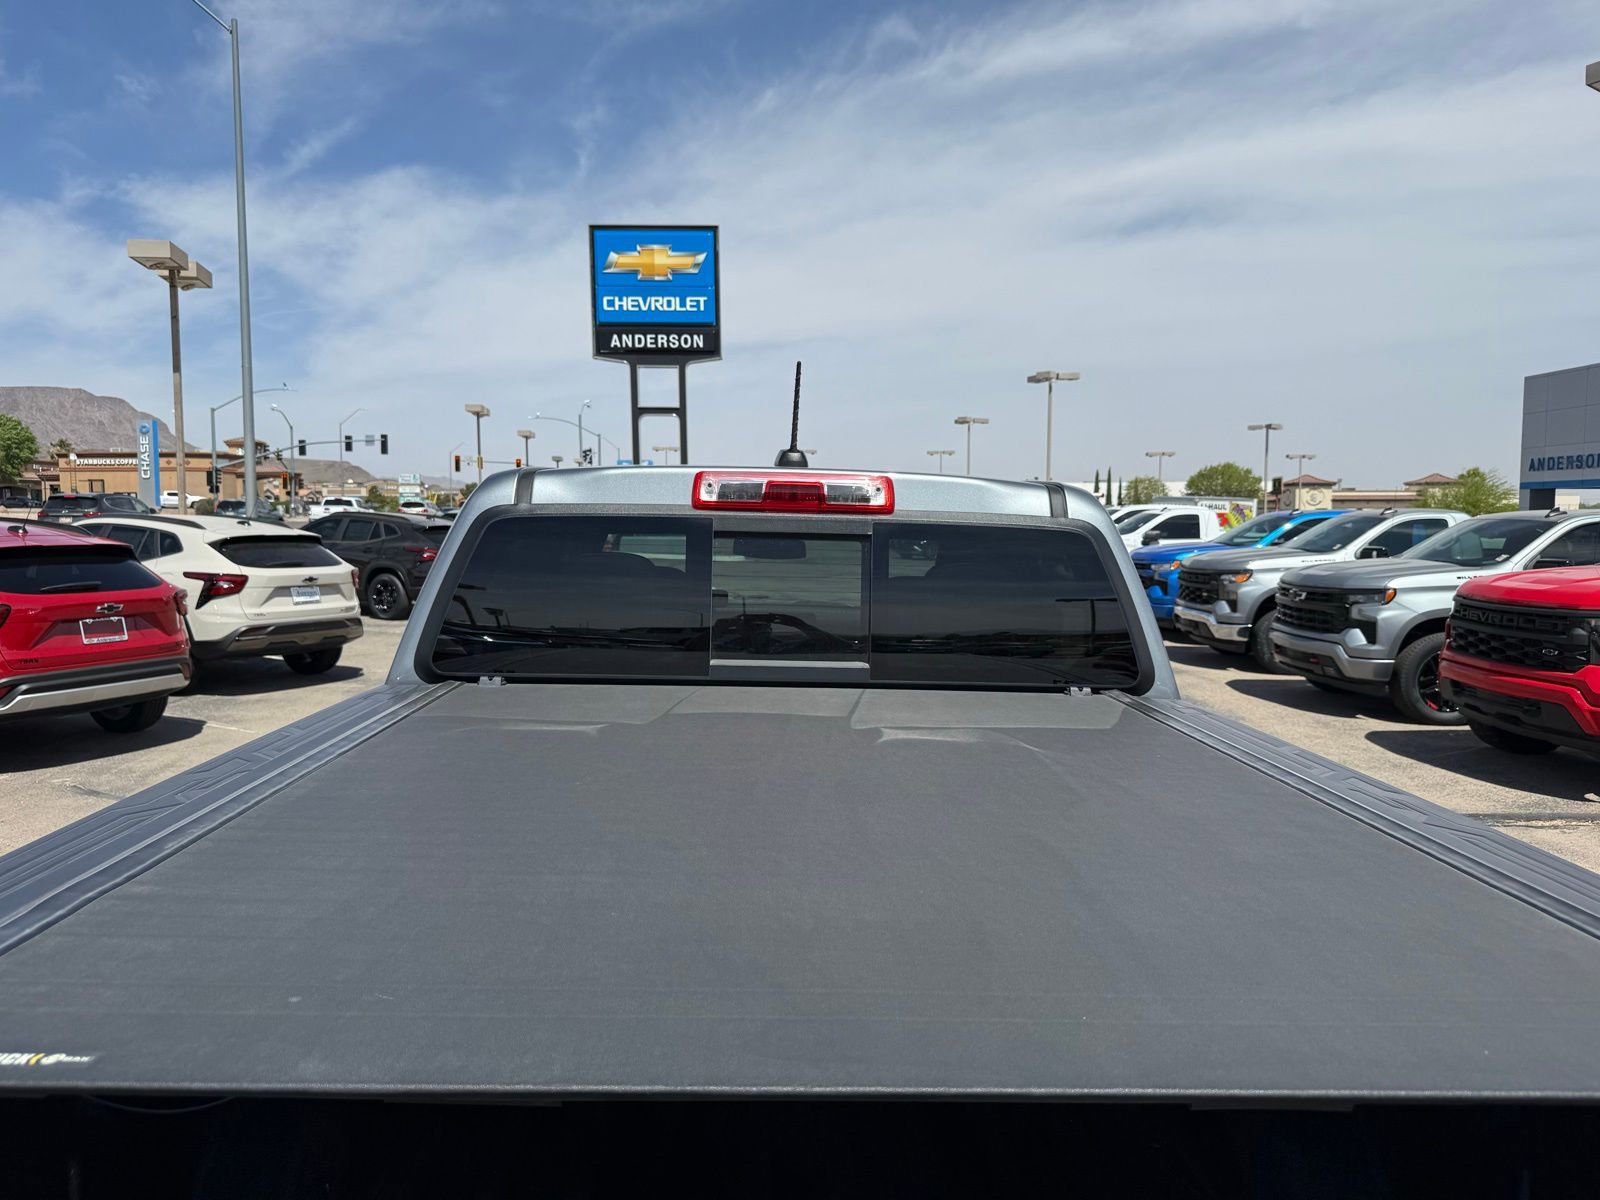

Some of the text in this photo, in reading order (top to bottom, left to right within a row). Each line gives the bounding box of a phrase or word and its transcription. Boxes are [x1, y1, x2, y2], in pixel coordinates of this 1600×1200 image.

[602, 296, 708, 311] CHEVROLET
[610, 334, 704, 348] ANDERSON
[140, 434, 151, 479] CHASE
[1528, 453, 1600, 472] ANDERSO
